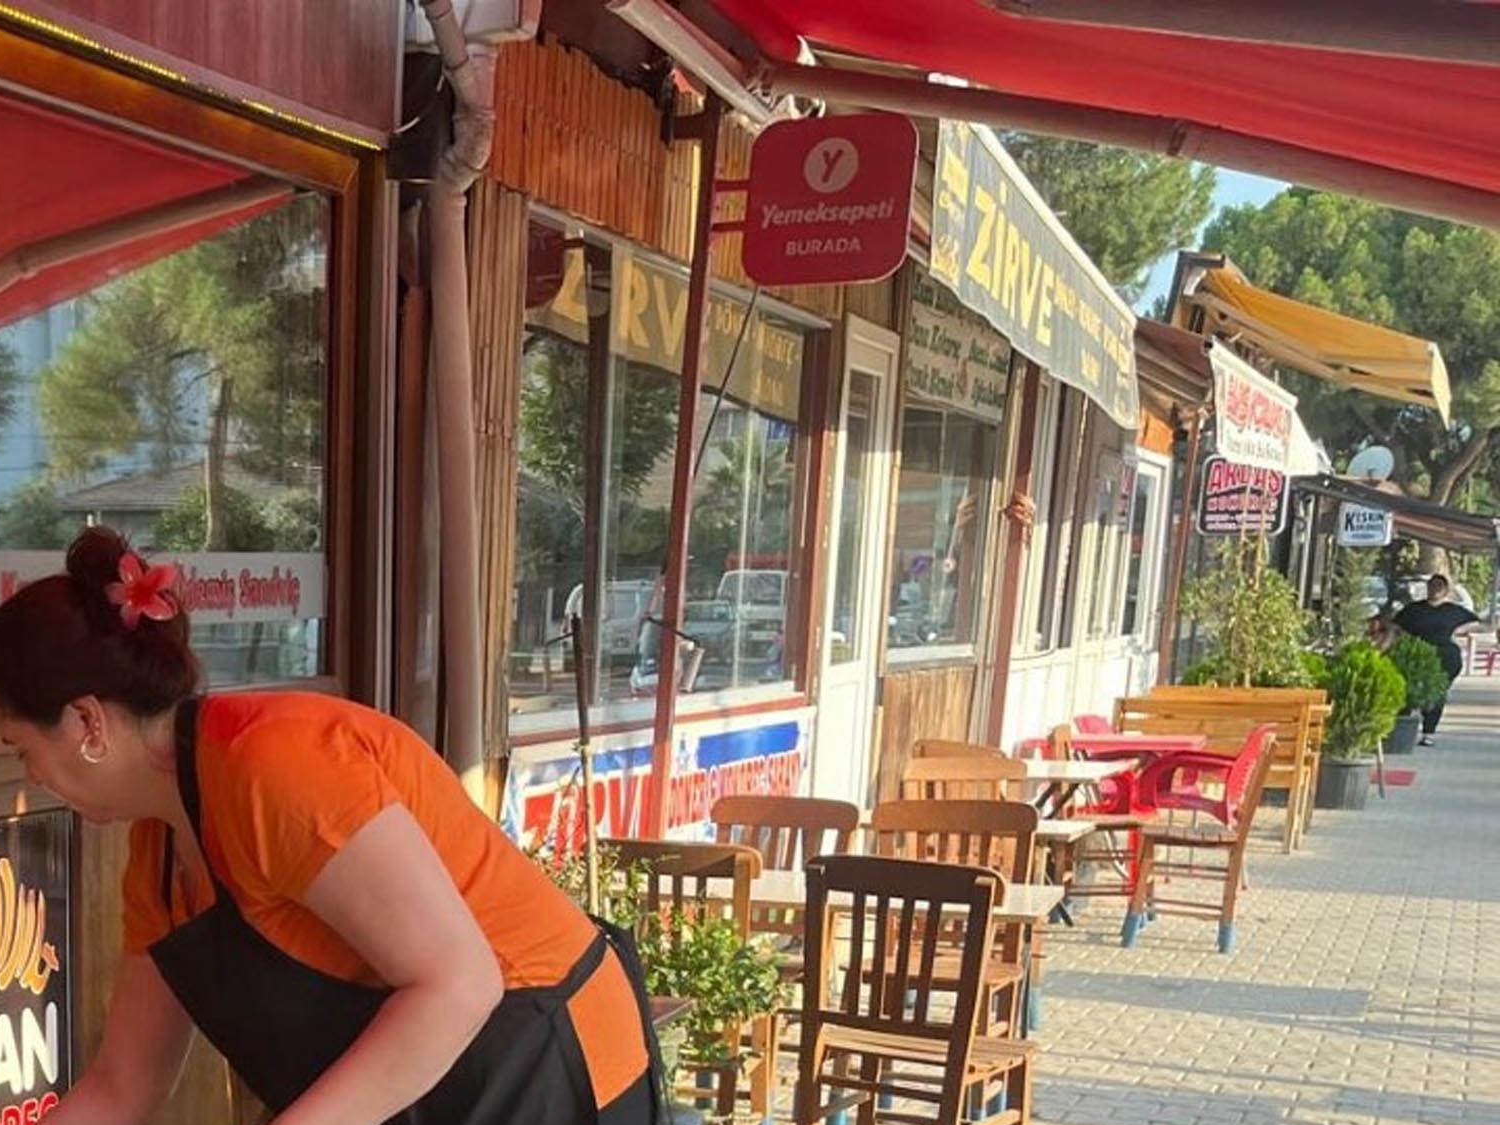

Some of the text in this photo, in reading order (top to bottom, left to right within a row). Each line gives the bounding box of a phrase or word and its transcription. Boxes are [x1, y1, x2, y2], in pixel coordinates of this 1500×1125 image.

[761, 199, 896, 229] Yemeksepeti
[785, 237, 862, 256] BURADA
[966, 180, 1056, 348] ZİRVE
